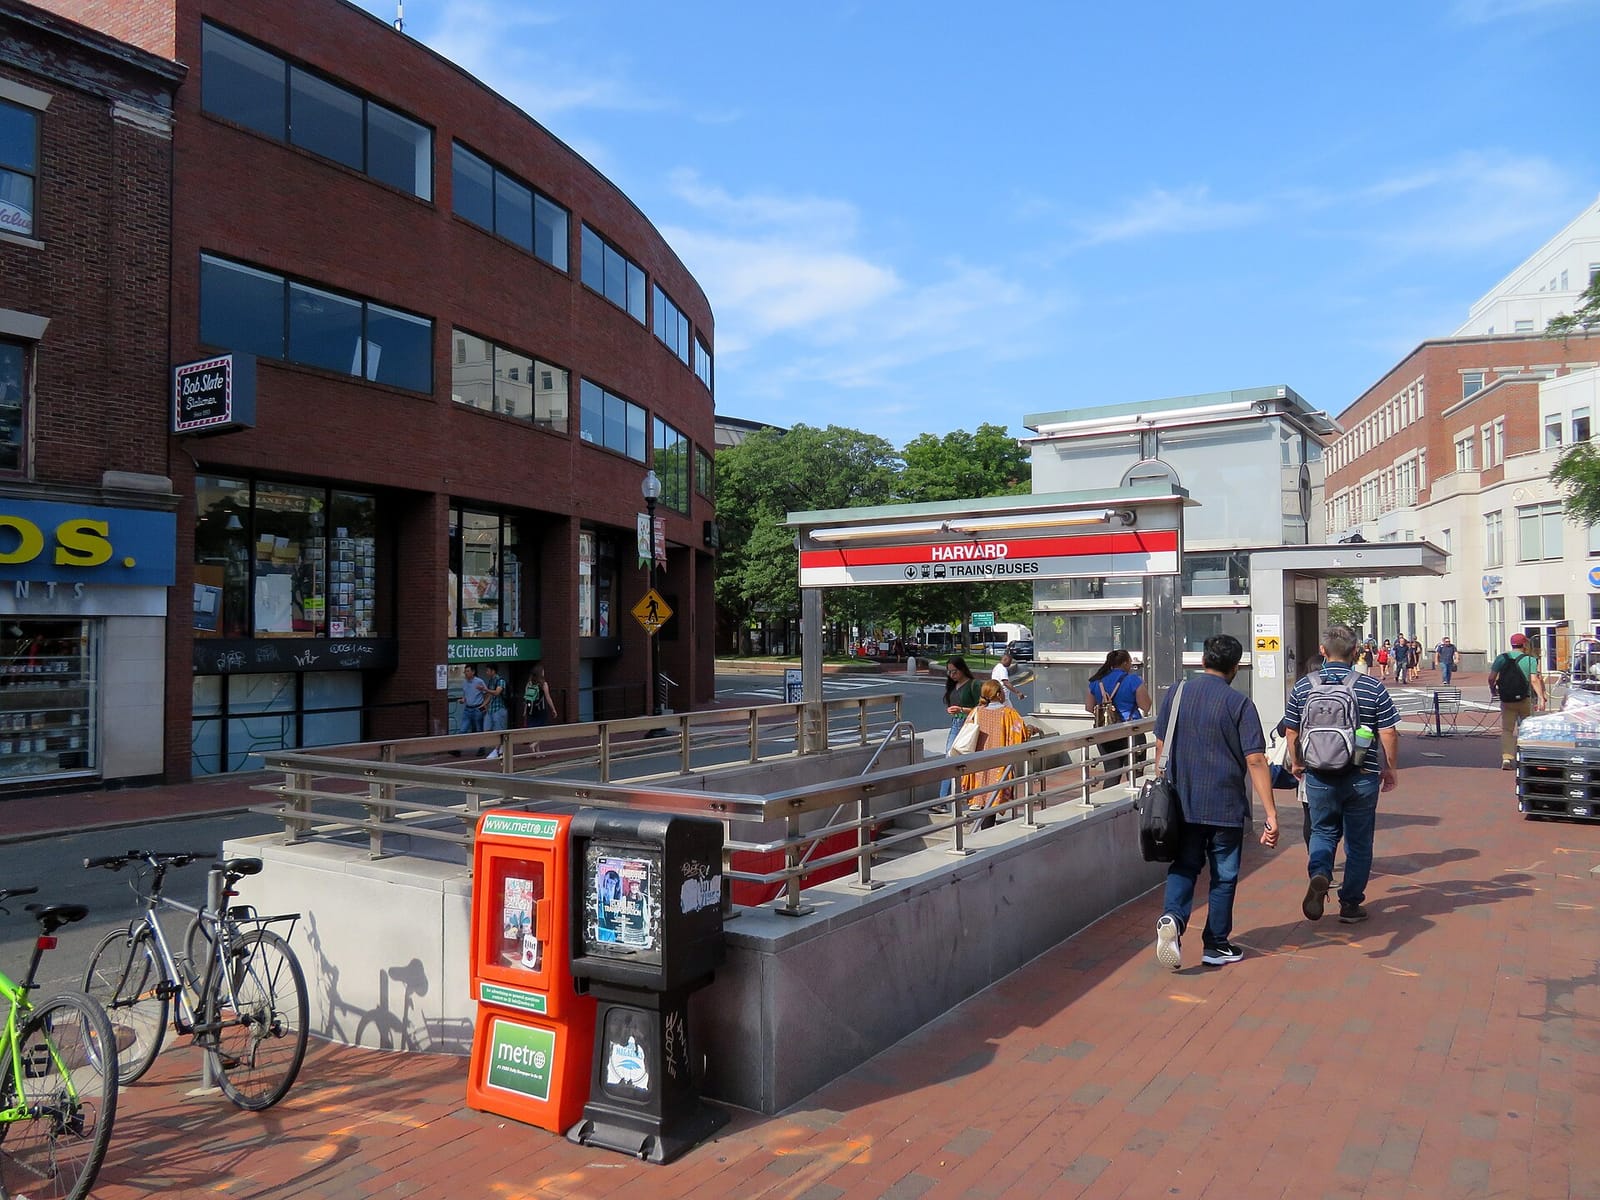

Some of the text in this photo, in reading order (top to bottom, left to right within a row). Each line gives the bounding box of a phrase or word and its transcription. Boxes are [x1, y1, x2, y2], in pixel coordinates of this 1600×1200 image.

[182, 372, 224, 396] Bob Slate
[931, 544, 1008, 560] HARVARD
[950, 562, 1039, 576] TRAINS/BUSES
[15, 580, 85, 600] NTS
[456, 643, 519, 658] Citizens Bank
[486, 819, 556, 835] www.metro.us
[498, 1043, 546, 1069] metro
